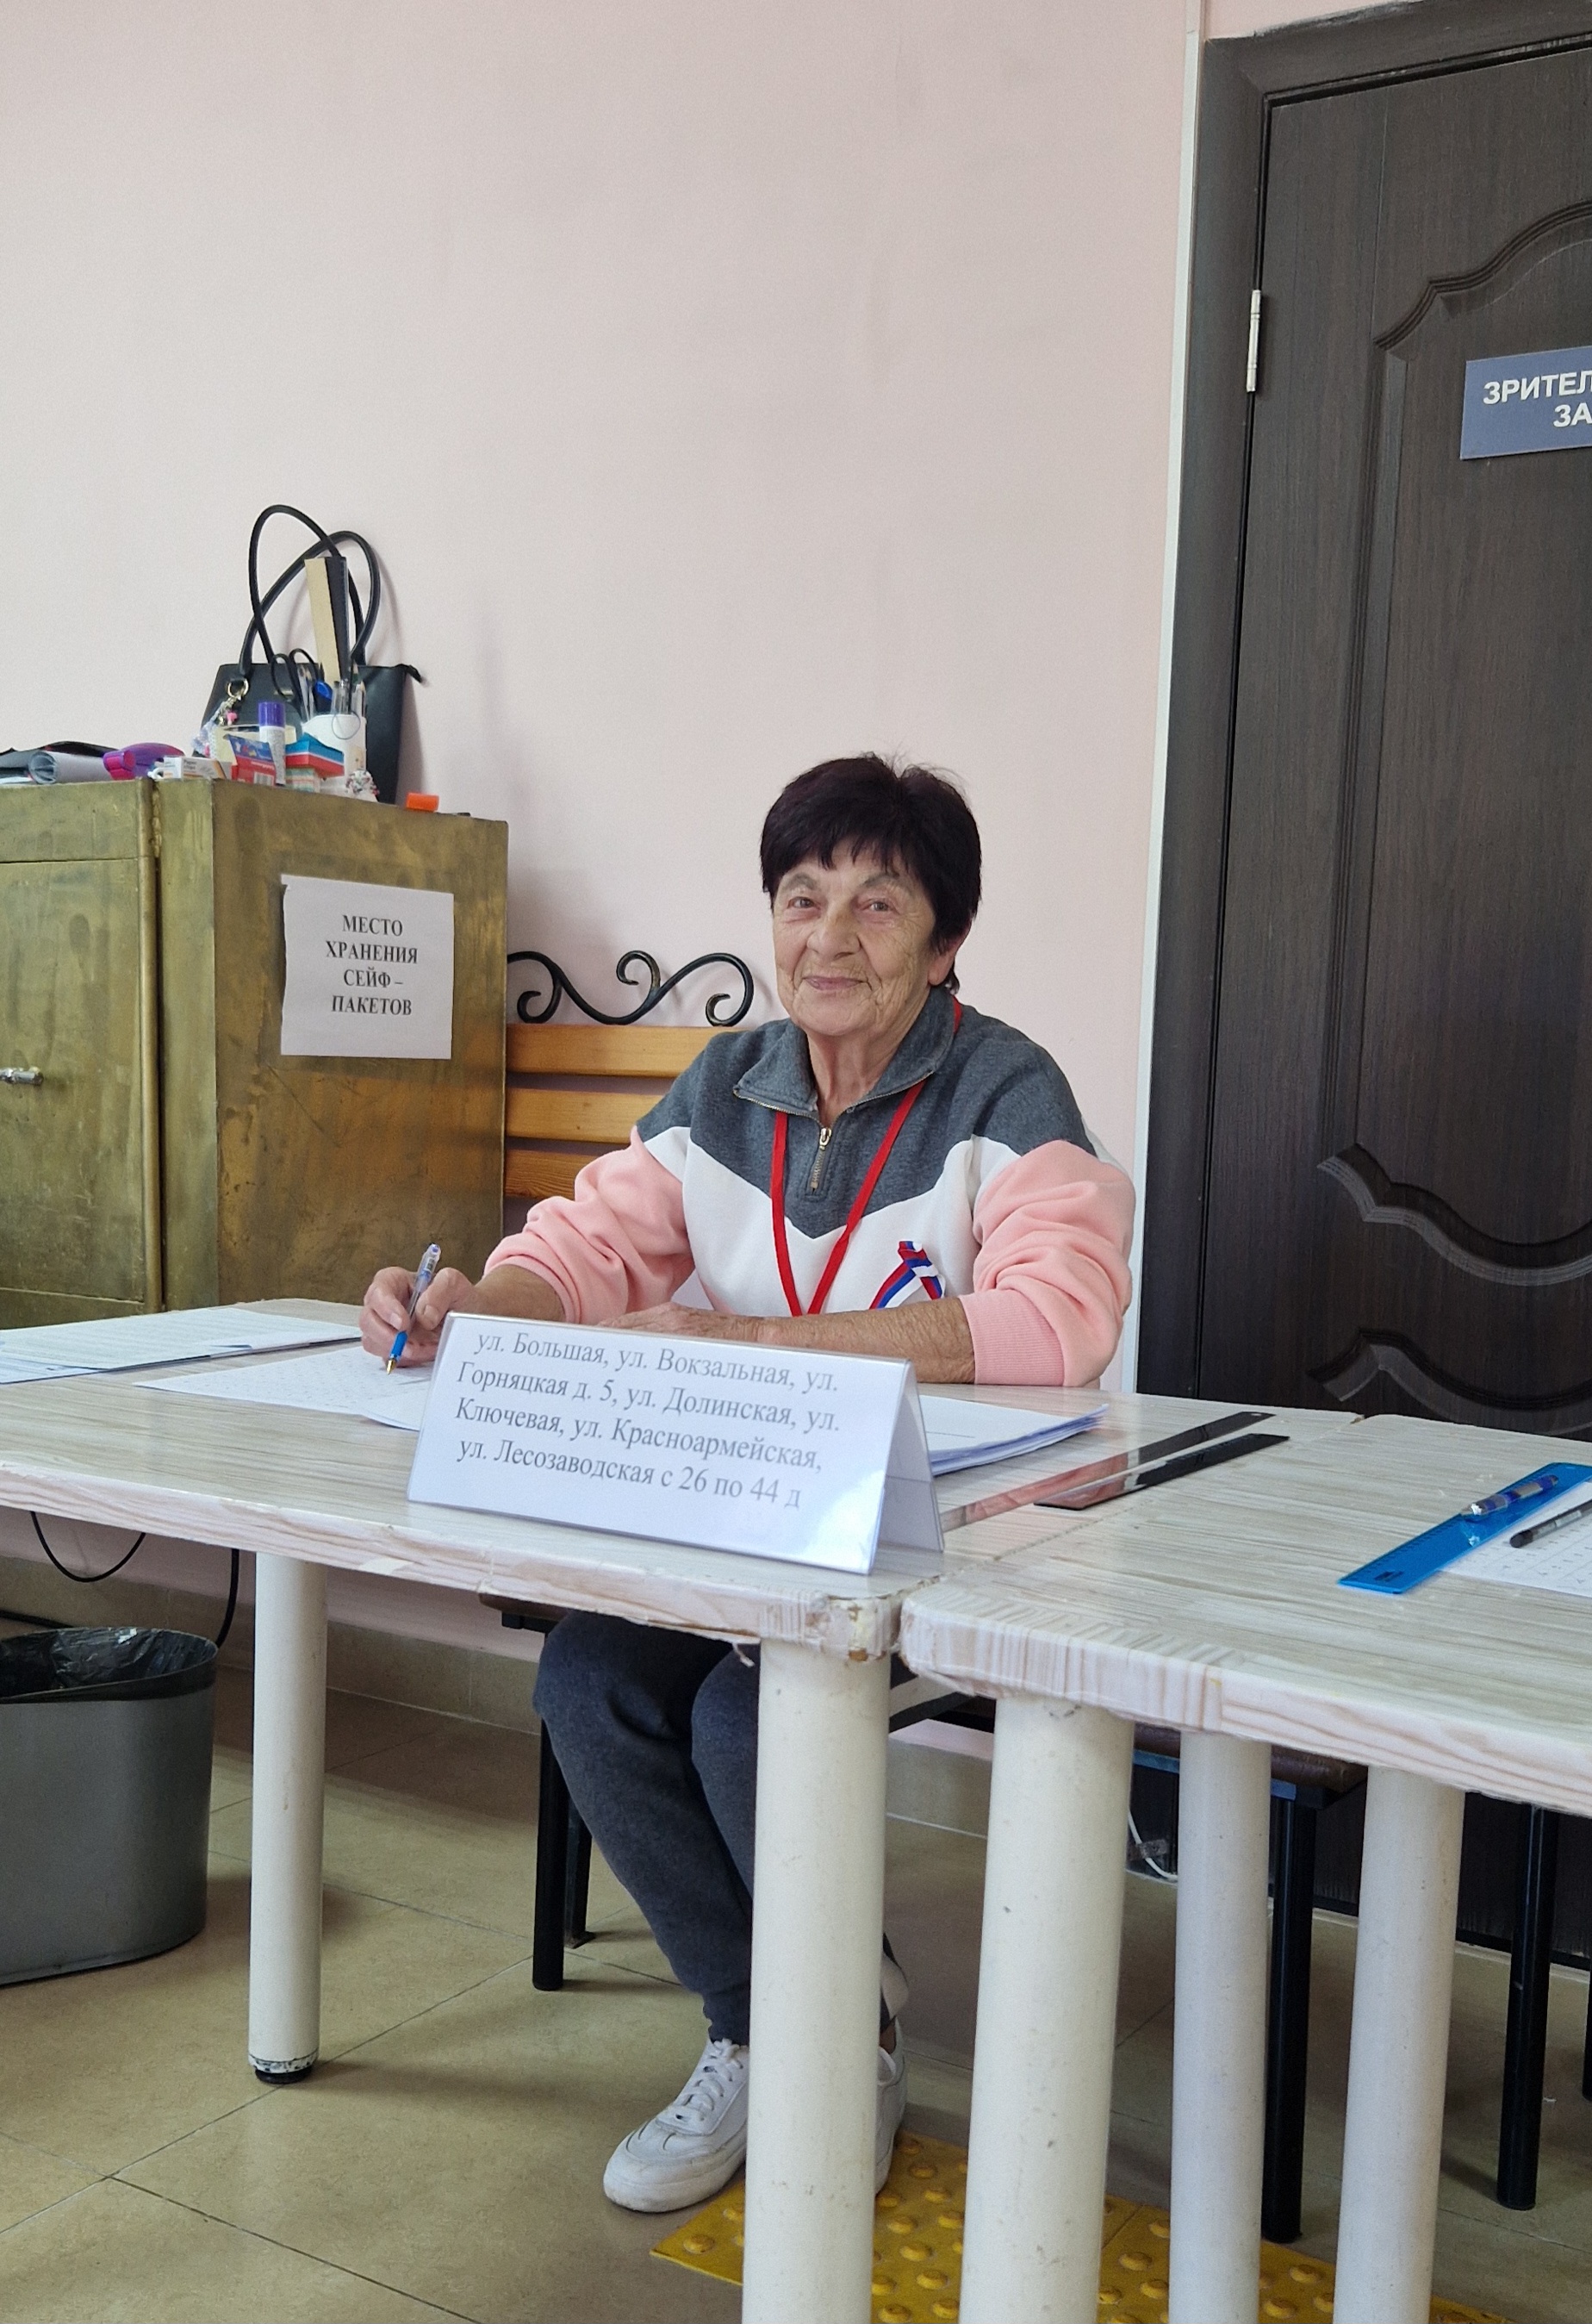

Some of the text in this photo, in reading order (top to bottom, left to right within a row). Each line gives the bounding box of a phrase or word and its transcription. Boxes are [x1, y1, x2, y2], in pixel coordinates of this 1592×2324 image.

[1483, 370, 1592, 405] ЗРИТЕЛ
[1553, 402, 1592, 427] ЗА
[342, 914, 403, 937] МЕСТО
[326, 940, 418, 964] ХРАНЕНИЯ
[343, 966, 391, 988] СЕЙФ
[331, 994, 412, 1016] ПАКЕТОВ
[474, 1332, 838, 1394] ул. Большая, ул. Вокзальная, ул.
[457, 1361, 839, 1435] Горняцкая д. 5, ул. Долинская, ул.
[456, 1397, 822, 1474] Ключевая, ул. Красноармейская,
[457, 1439, 801, 1509] ул. Лесозаводская с 26 по 44 д
